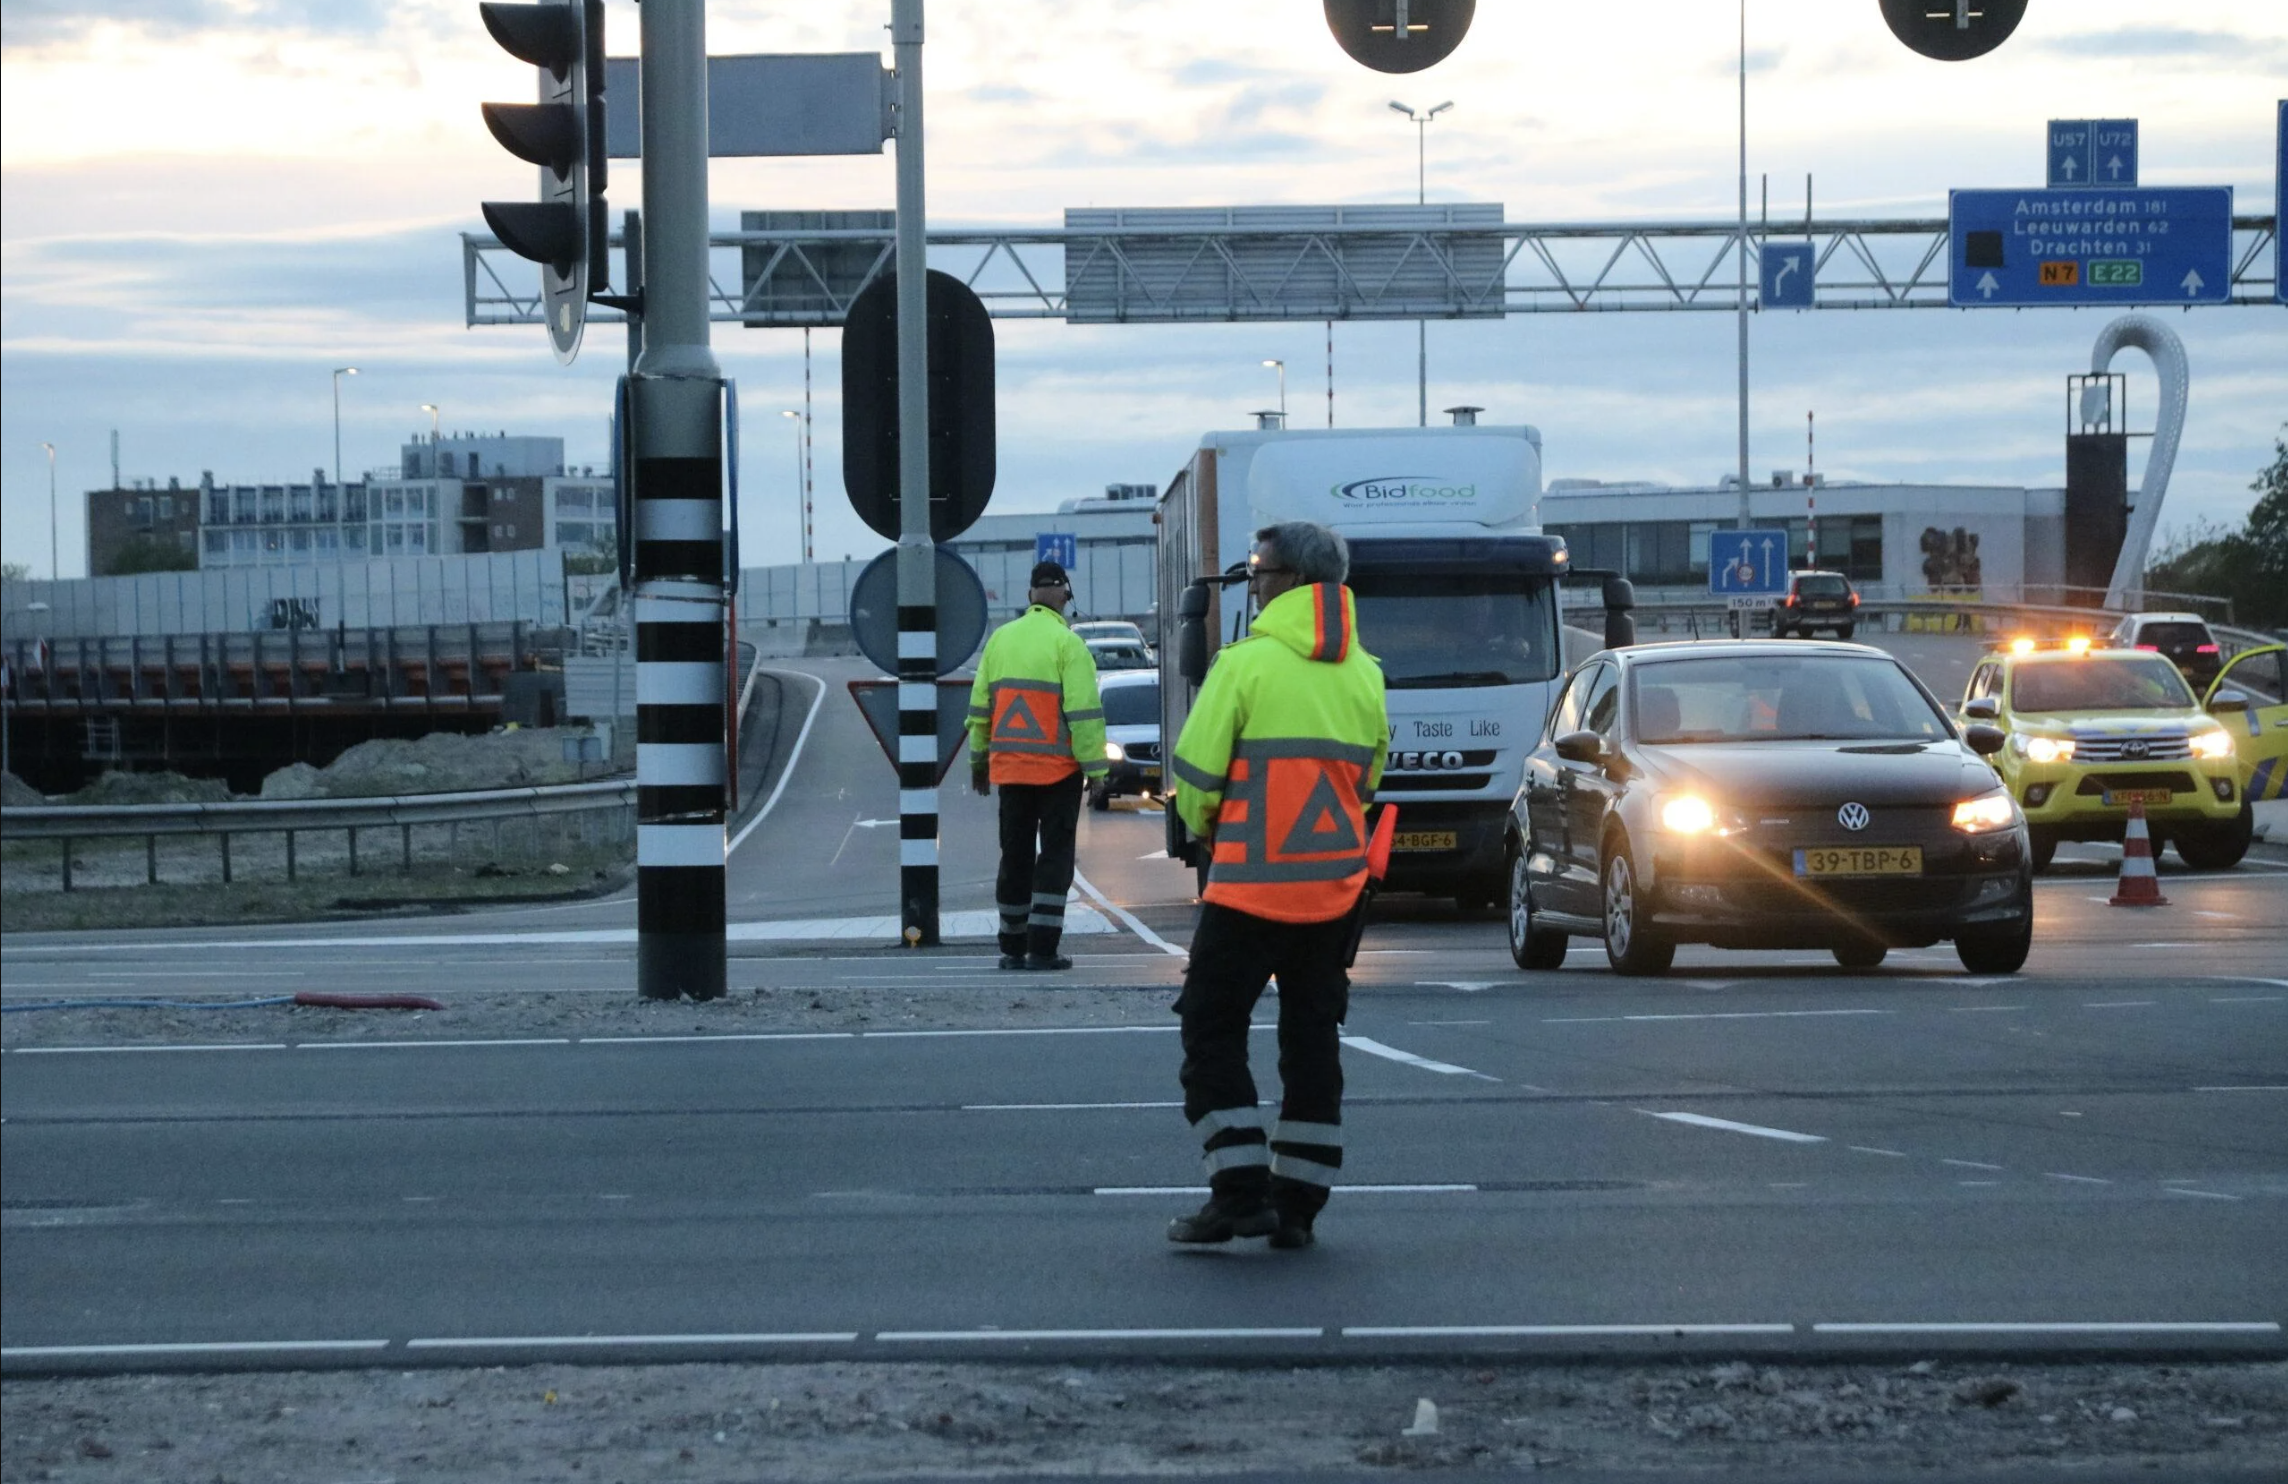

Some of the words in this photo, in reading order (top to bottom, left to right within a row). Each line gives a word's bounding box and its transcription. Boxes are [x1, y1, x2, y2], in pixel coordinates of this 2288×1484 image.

[2053, 132, 2086, 147] U57
[2100, 132, 2132, 147] U72
[2015, 199, 2136, 215] Amsterdam
[2145, 200, 2167, 214] 181
[2014, 219, 2140, 236] Leeuwarden
[2148, 221, 2169, 235] 62
[2030, 239, 2127, 256] Drachten
[2136, 241, 2150, 255] 31
[1365, 484, 1476, 499] Bidfood
[1733, 598, 1753, 608] 150
[1414, 720, 1453, 738] Taste
[1470, 720, 1500, 737] Like
[1385, 751, 1464, 771] VECO
[1813, 852, 1913, 872] 39-TBP-6
